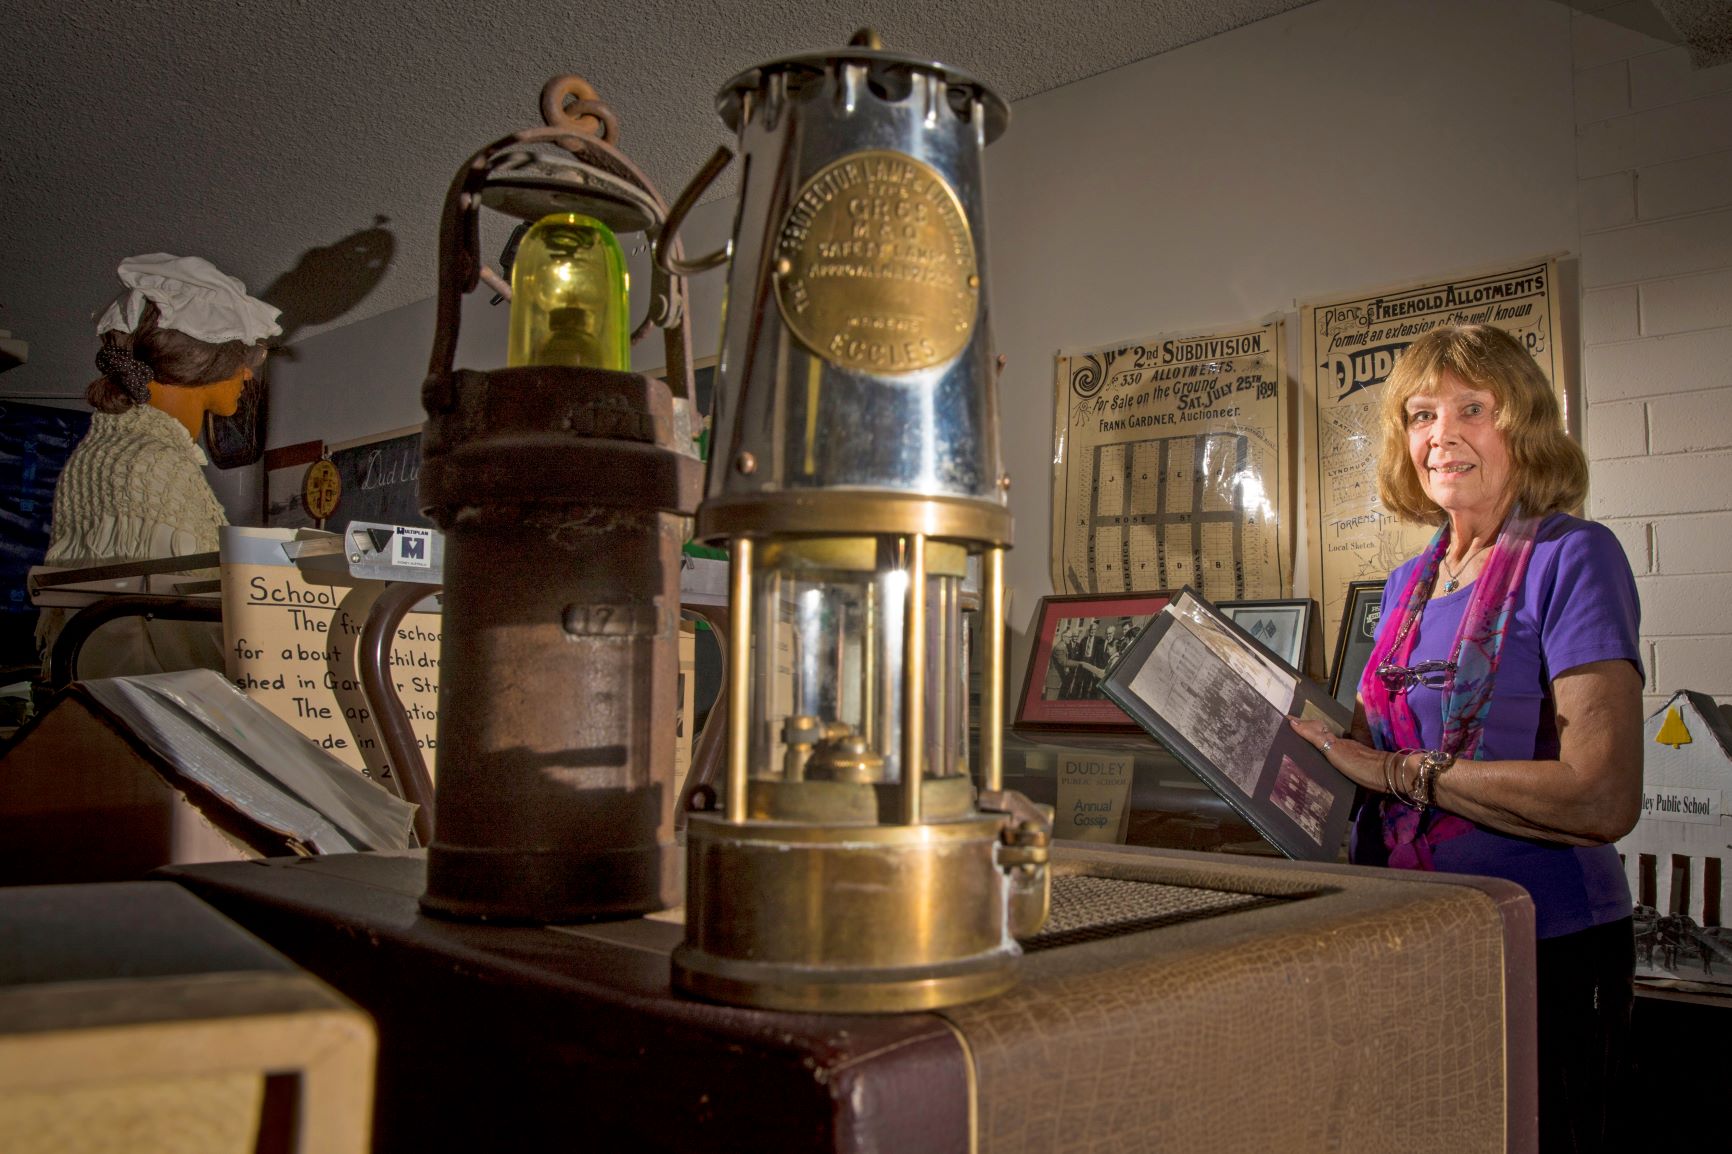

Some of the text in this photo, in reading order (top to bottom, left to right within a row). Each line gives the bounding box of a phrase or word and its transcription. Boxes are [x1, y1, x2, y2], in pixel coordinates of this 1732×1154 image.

[1325, 276, 1544, 337] Plan of FREEHOLD ALLOTMENTS
[1369, 328, 1383, 343] an
[1385, 317, 1436, 339] extension
[1493, 303, 1533, 321] known
[1162, 334, 1262, 365] SUBDIVISION
[1120, 372, 1143, 388] 330
[1111, 393, 1134, 410] Sale
[1136, 392, 1150, 405] on
[1153, 384, 1170, 401] the
[1172, 376, 1218, 395] Ground
[1204, 382, 1233, 408] JULY
[1256, 380, 1278, 401] 1891
[1099, 417, 1127, 433] FRANK
[1128, 412, 1178, 428] GARDNER,
[396, 526, 429, 536] MULTIPLAN
[1115, 516, 1147, 525] ROSE
[1328, 542, 1349, 552] Local
[250, 576, 336, 607] School
[288, 609, 328, 633] The
[234, 638, 264, 659] for
[281, 643, 342, 662] about
[236, 672, 286, 690] shed
[296, 674, 316, 690] in
[292, 697, 333, 719] The
[358, 734, 375, 749] in
[1065, 761, 1126, 776] DUDLEY
[1073, 799, 1113, 812] Annual
[1656, 793, 1681, 813] Public
[1683, 795, 1710, 815] School
[1073, 812, 1109, 829] Gossip
